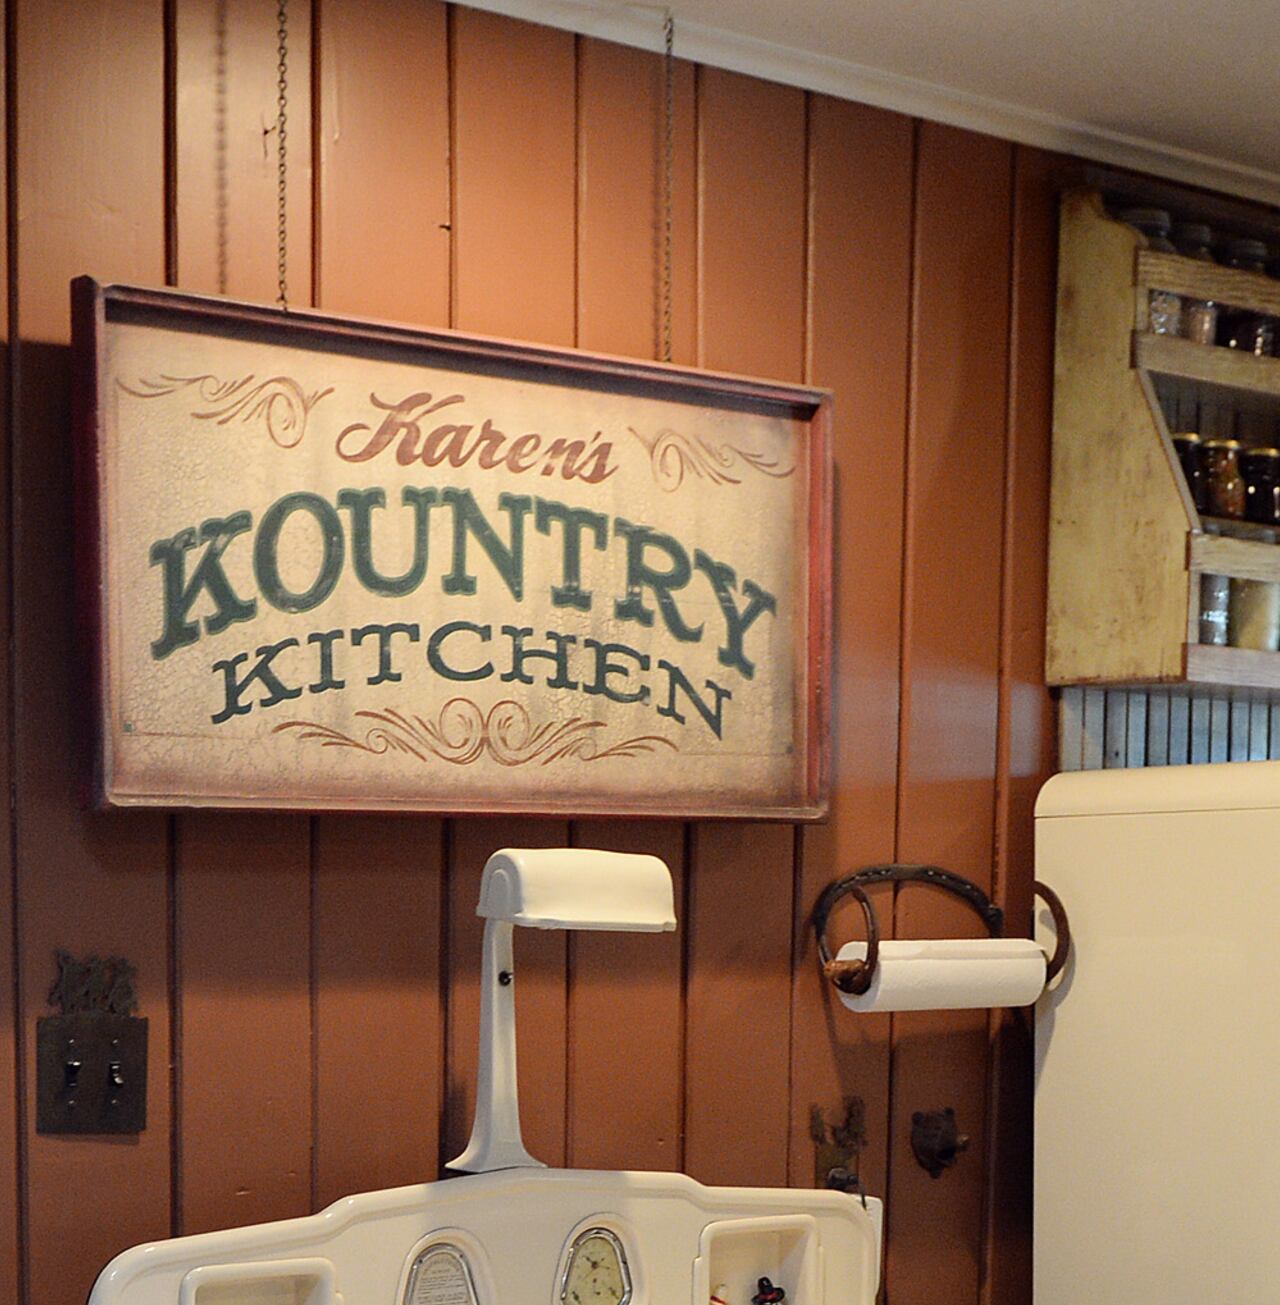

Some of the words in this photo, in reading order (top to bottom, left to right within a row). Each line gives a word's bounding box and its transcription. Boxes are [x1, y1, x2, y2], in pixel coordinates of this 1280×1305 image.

[336, 390, 619, 484] Karen's
[149, 486, 777, 680] KOUNTRY
[211, 620, 733, 741] KITCHEN
